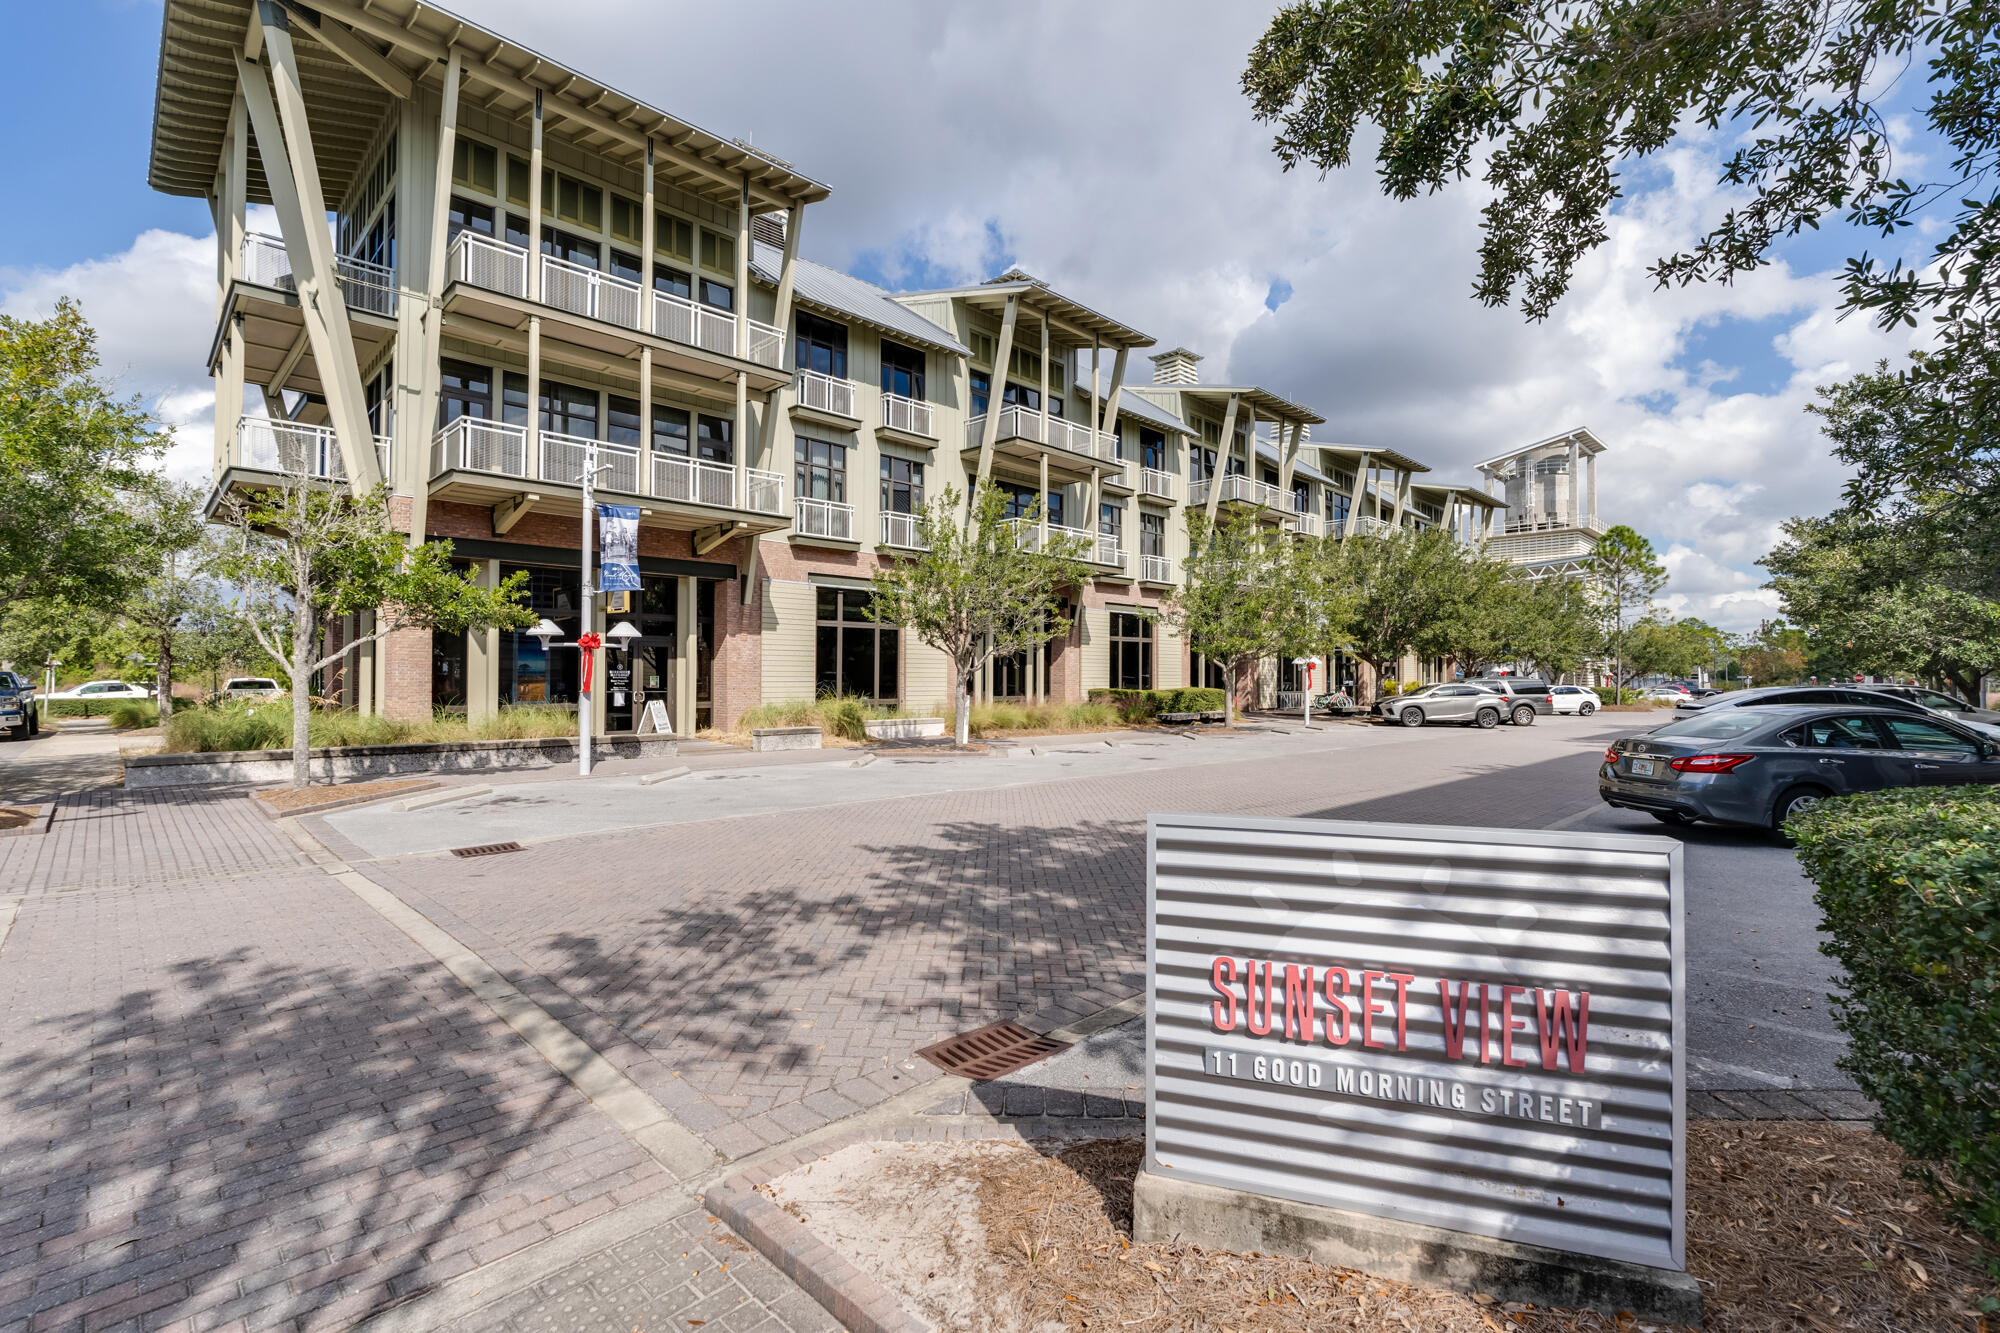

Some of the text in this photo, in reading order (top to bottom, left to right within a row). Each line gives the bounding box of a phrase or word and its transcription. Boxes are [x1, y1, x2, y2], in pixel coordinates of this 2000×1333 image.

[1213, 956, 1590, 1074] SUNSET VIEW
[1212, 1051, 1592, 1126] 11 GOOD MORNING STREET
